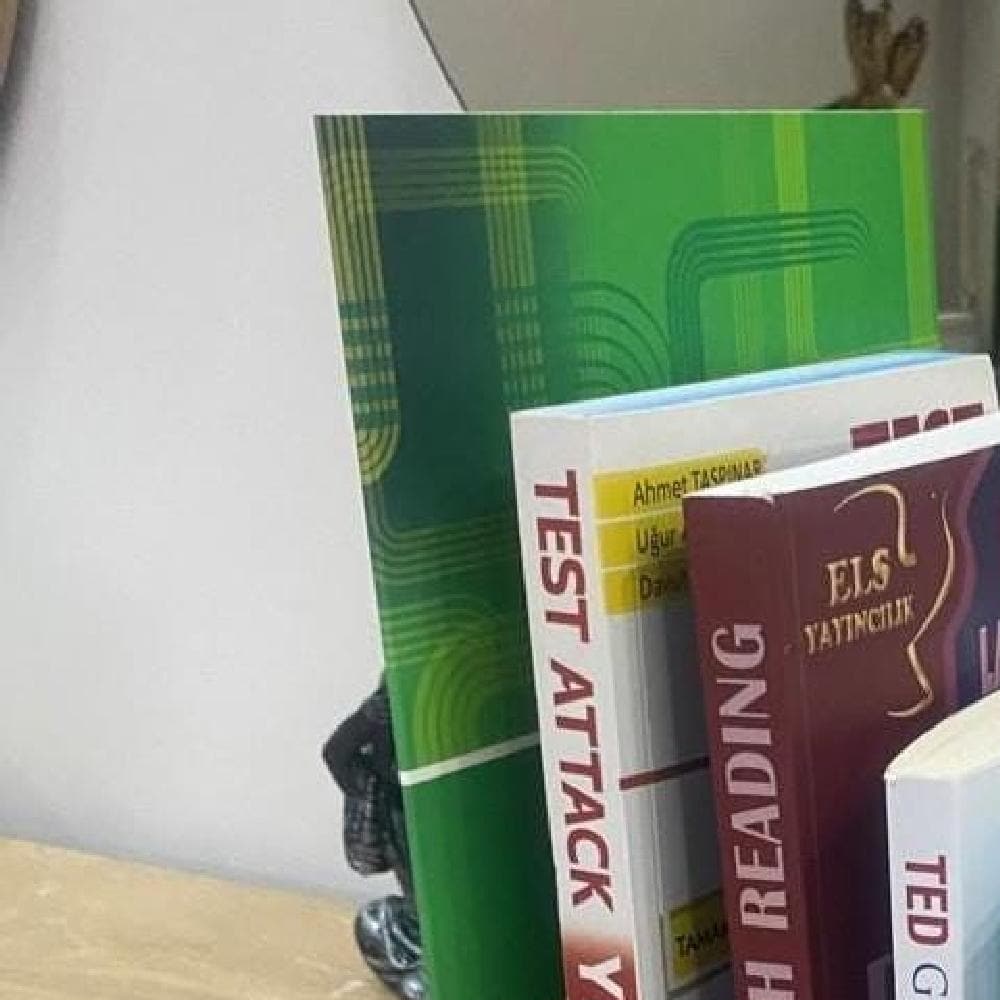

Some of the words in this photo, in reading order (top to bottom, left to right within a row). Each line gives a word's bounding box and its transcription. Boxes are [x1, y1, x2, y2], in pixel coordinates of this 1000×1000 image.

[533, 469, 590, 643] TEST
[633, 477, 687, 507] Ahmet
[826, 548, 890, 608] ELS
[550, 657, 614, 912] ATTACK
[711, 623, 790, 929] READING
[904, 854, 950, 947] TED
